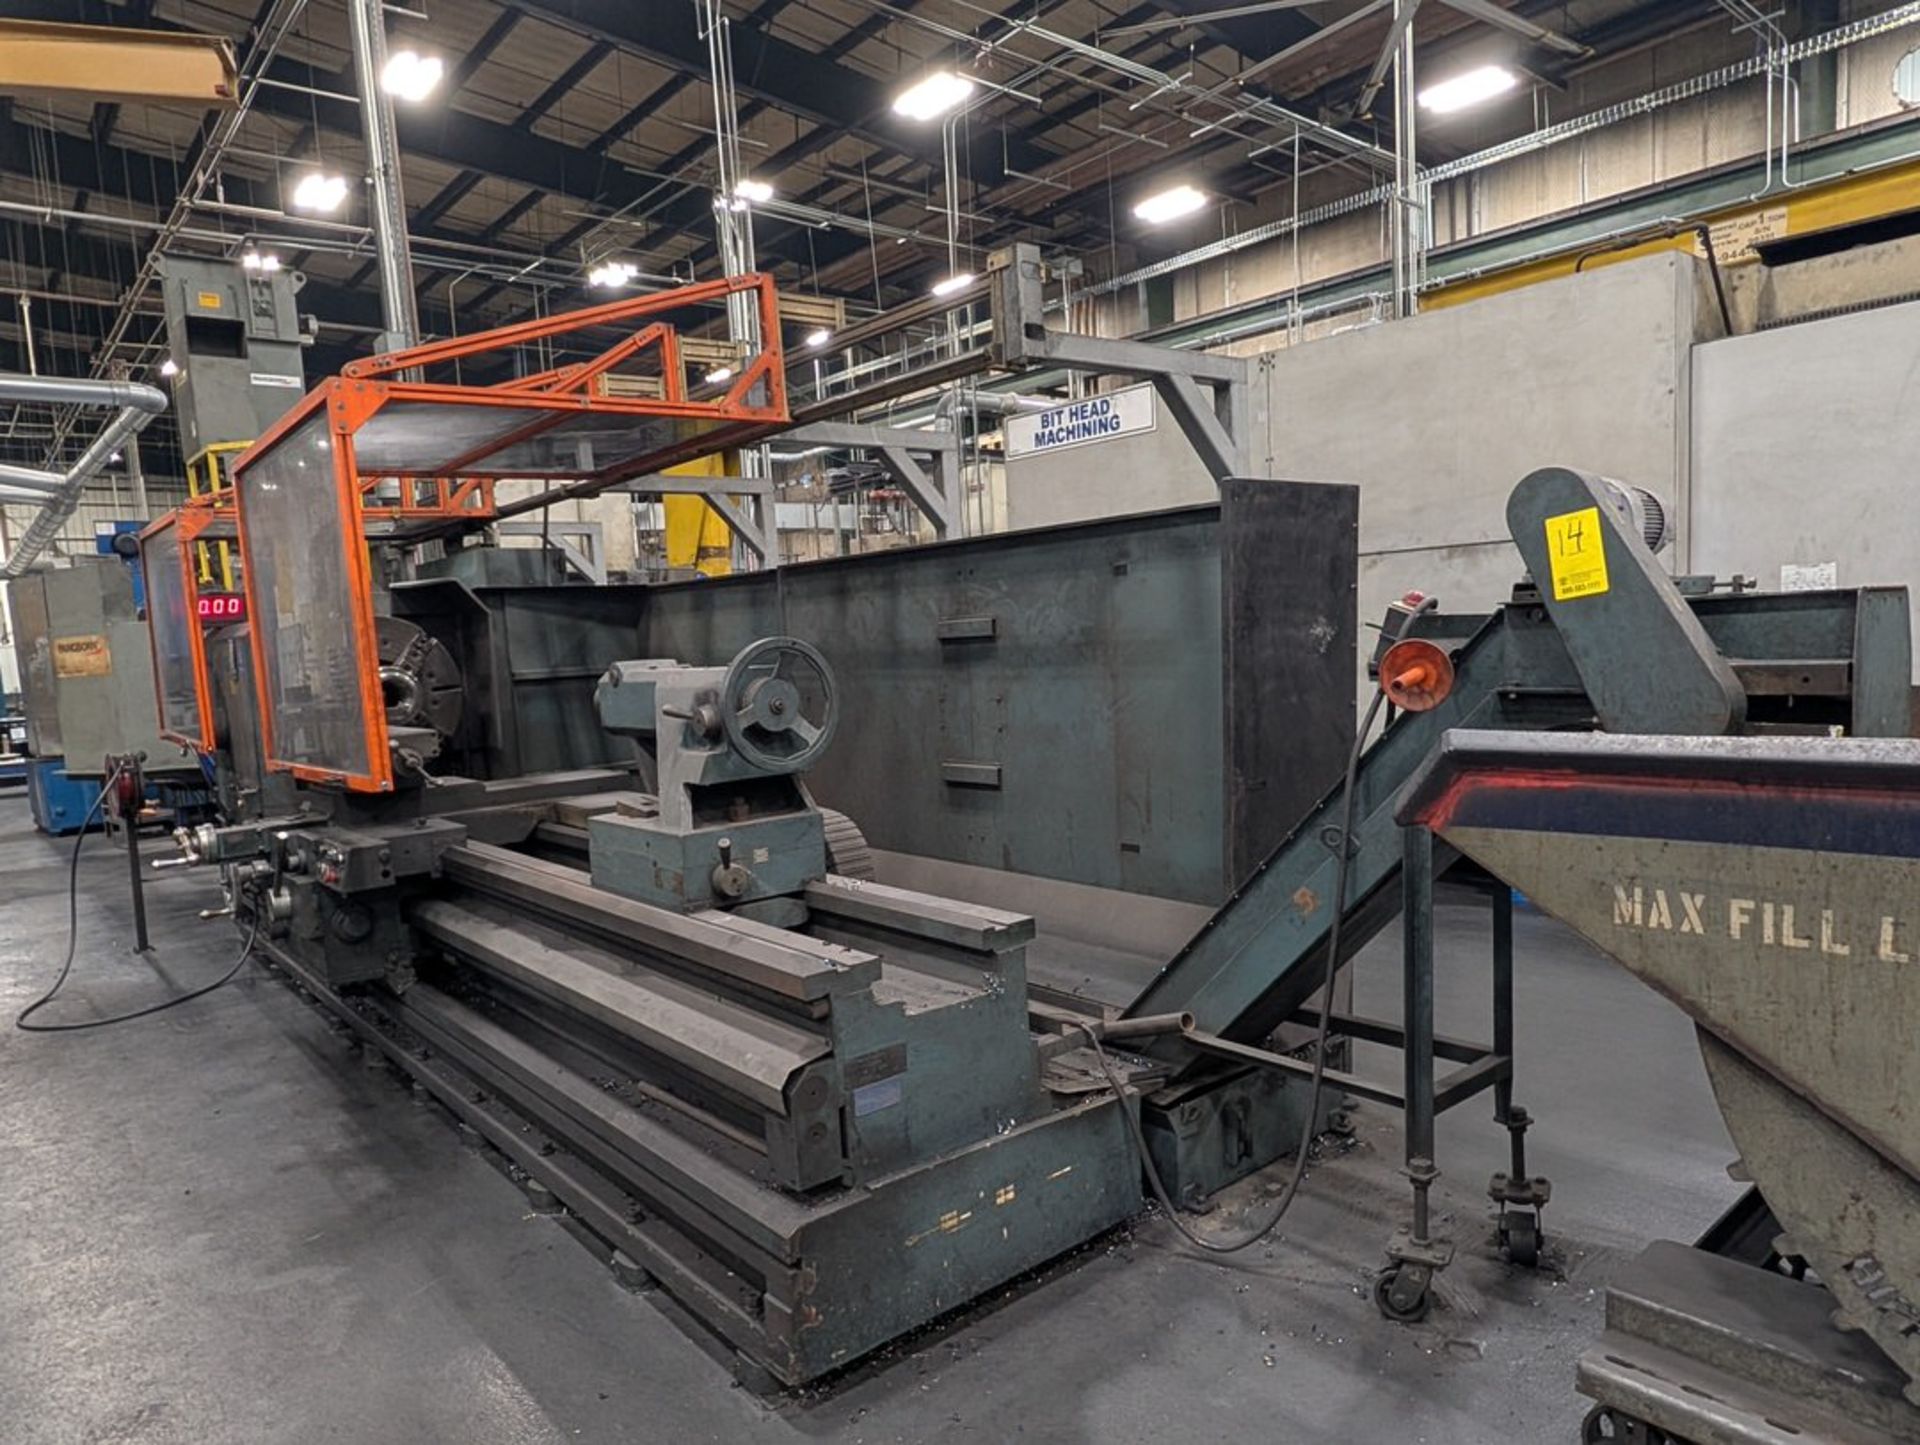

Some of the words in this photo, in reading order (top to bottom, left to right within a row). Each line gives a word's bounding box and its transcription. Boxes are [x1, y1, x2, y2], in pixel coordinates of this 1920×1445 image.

[1034, 415, 1121, 448] MACHINING
[1040, 410, 1063, 430] BIT
[1069, 399, 1110, 422] HEAD
[1558, 519, 1584, 557] 14
[1613, 885, 1705, 935] MAX
[1729, 898, 1850, 956] FILL
